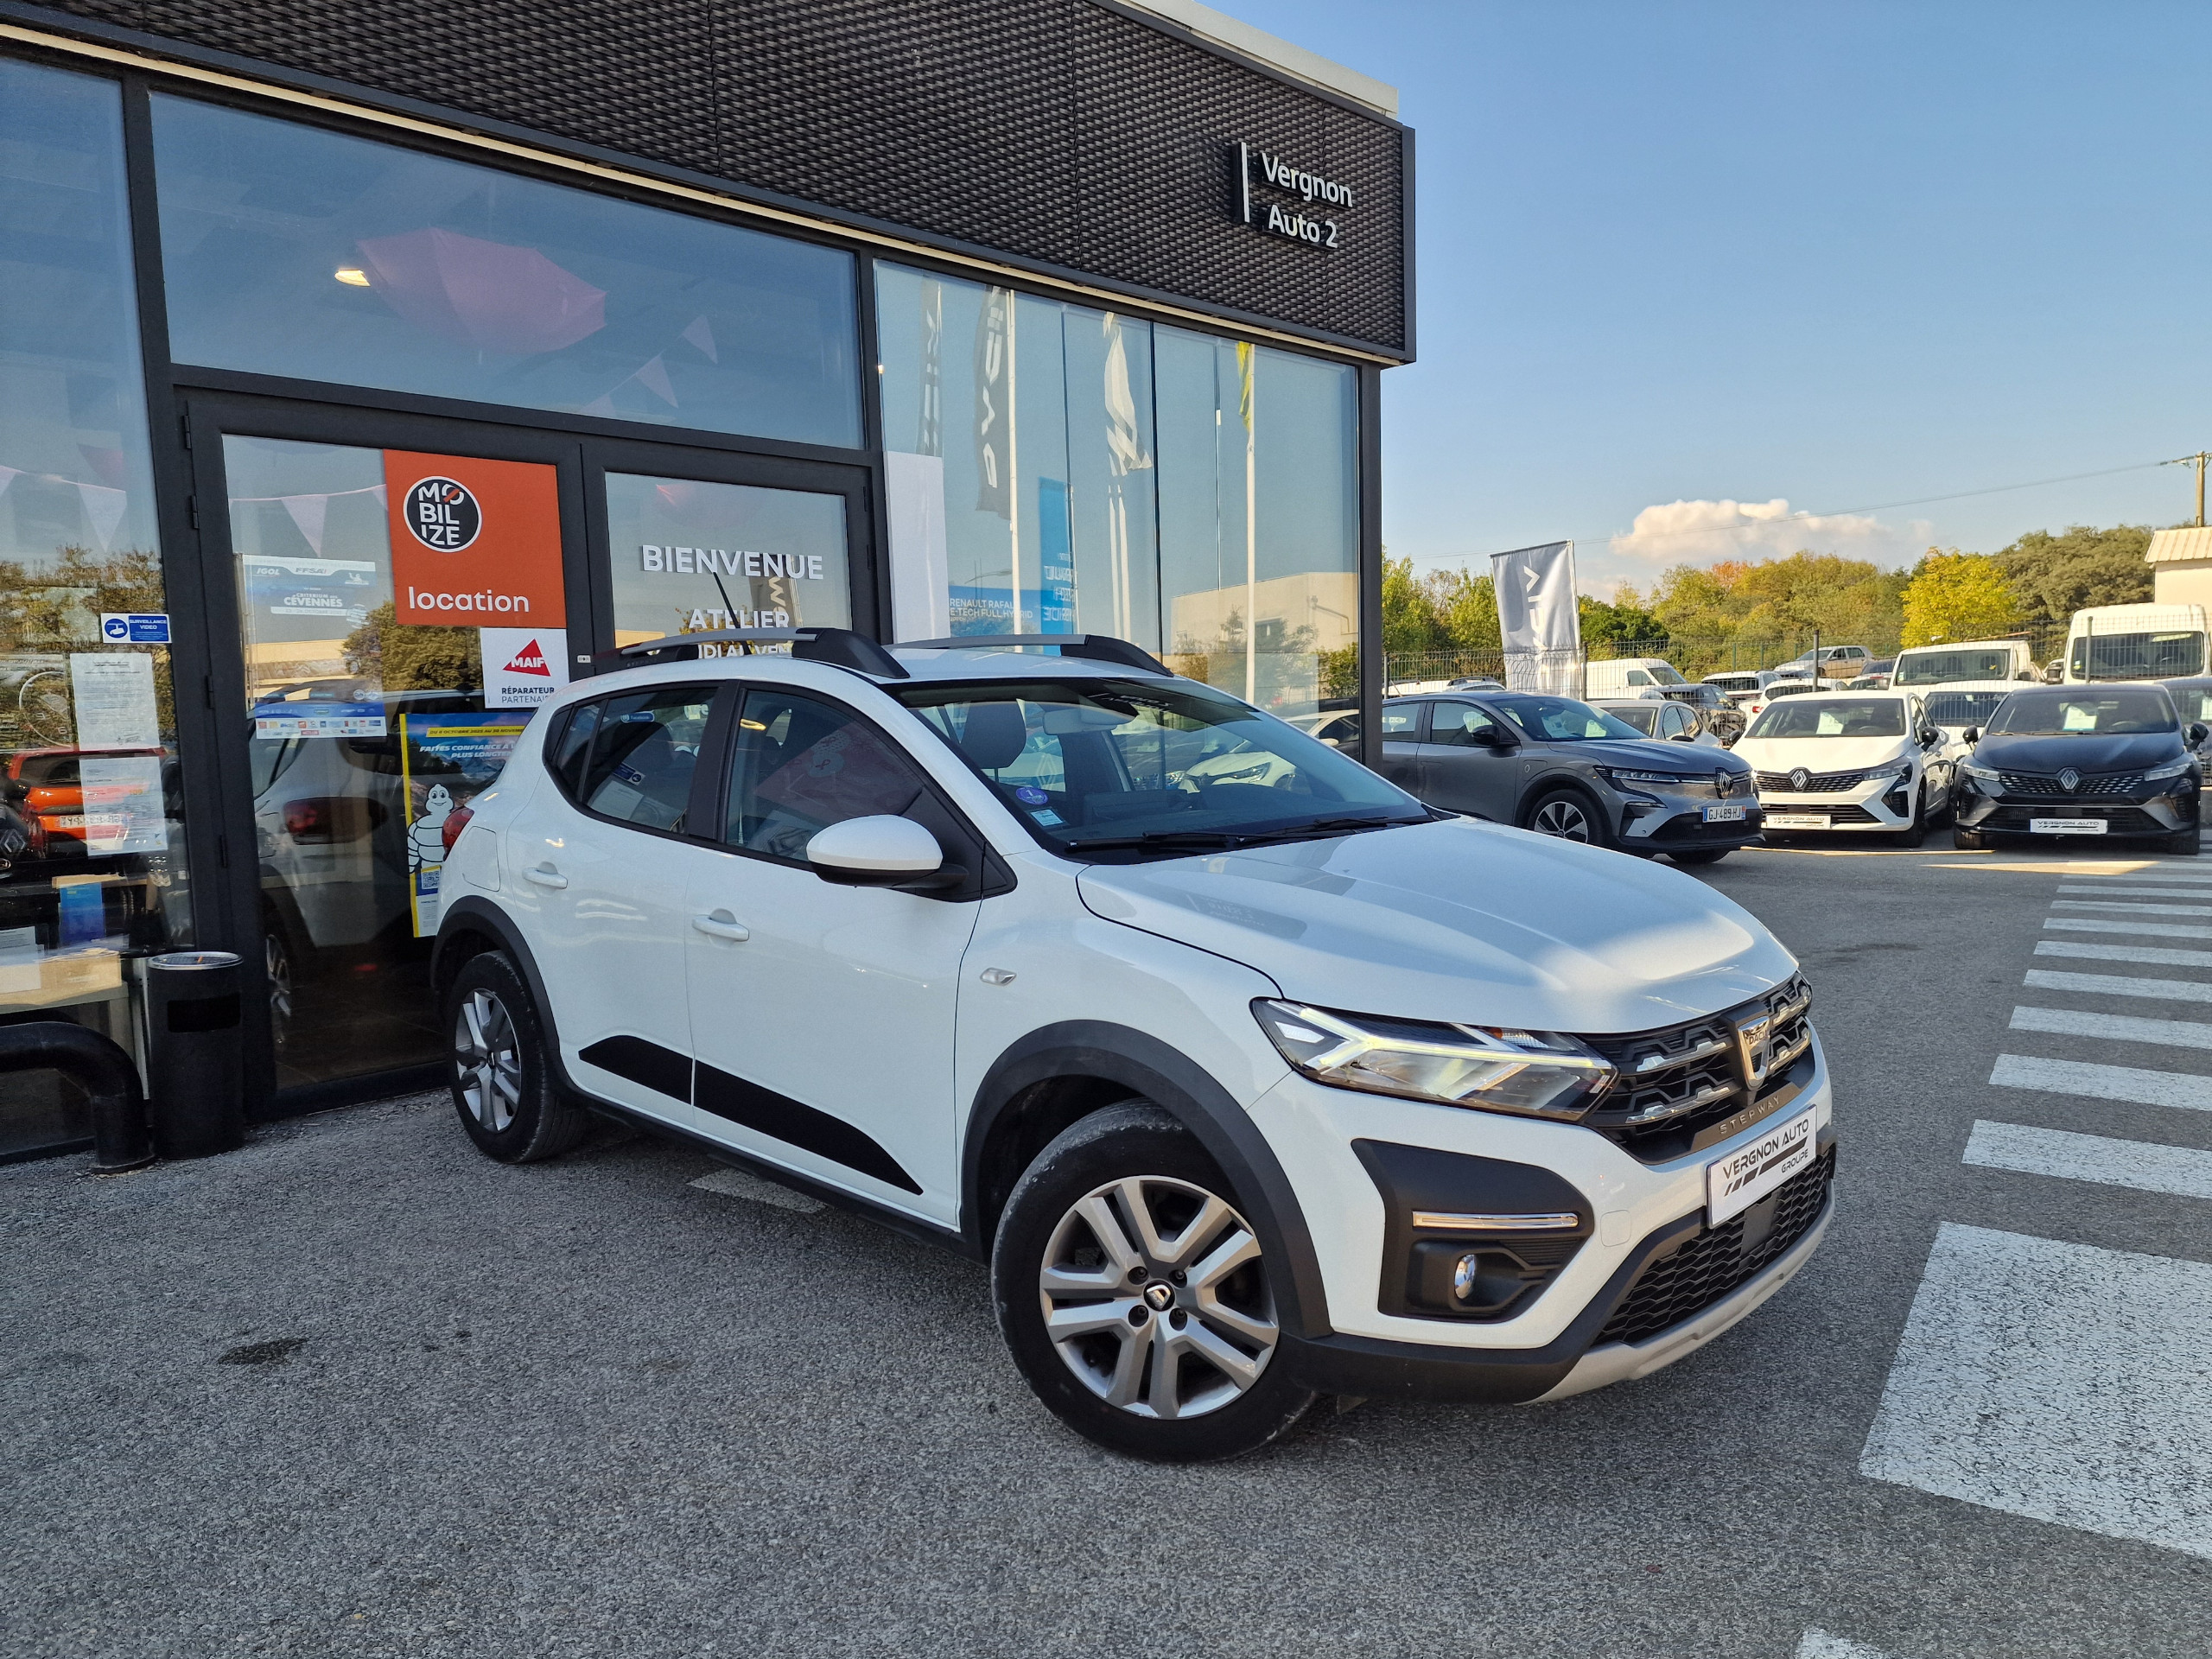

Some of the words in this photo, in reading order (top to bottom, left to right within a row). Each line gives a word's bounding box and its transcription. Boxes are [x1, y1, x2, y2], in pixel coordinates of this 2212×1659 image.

[1261, 152, 1353, 207] Vergnon
[1268, 205, 1320, 243] Auto
[1325, 220, 1338, 248] 2
[642, 544, 823, 580] BIENVENUE
[283, 594, 343, 607] CÉVENNES
[409, 586, 530, 613] location
[950, 598, 988, 607] RENAULT
[689, 608, 790, 629] ATELIER
[950, 608, 980, 617] E-TECH
[982, 609, 1002, 618] FULL
[511, 657, 544, 668] MAIF
[502, 686, 555, 695] RÉPARATEUR
[1708, 810, 1741, 821] GJ-489-HJ
[1719, 1095, 1780, 1135] STEPWAY
[1722, 1135, 1780, 1179] VERGNON
[1782, 1118, 1809, 1149] AUTO
[1781, 1148, 1809, 1173] GROUPE
